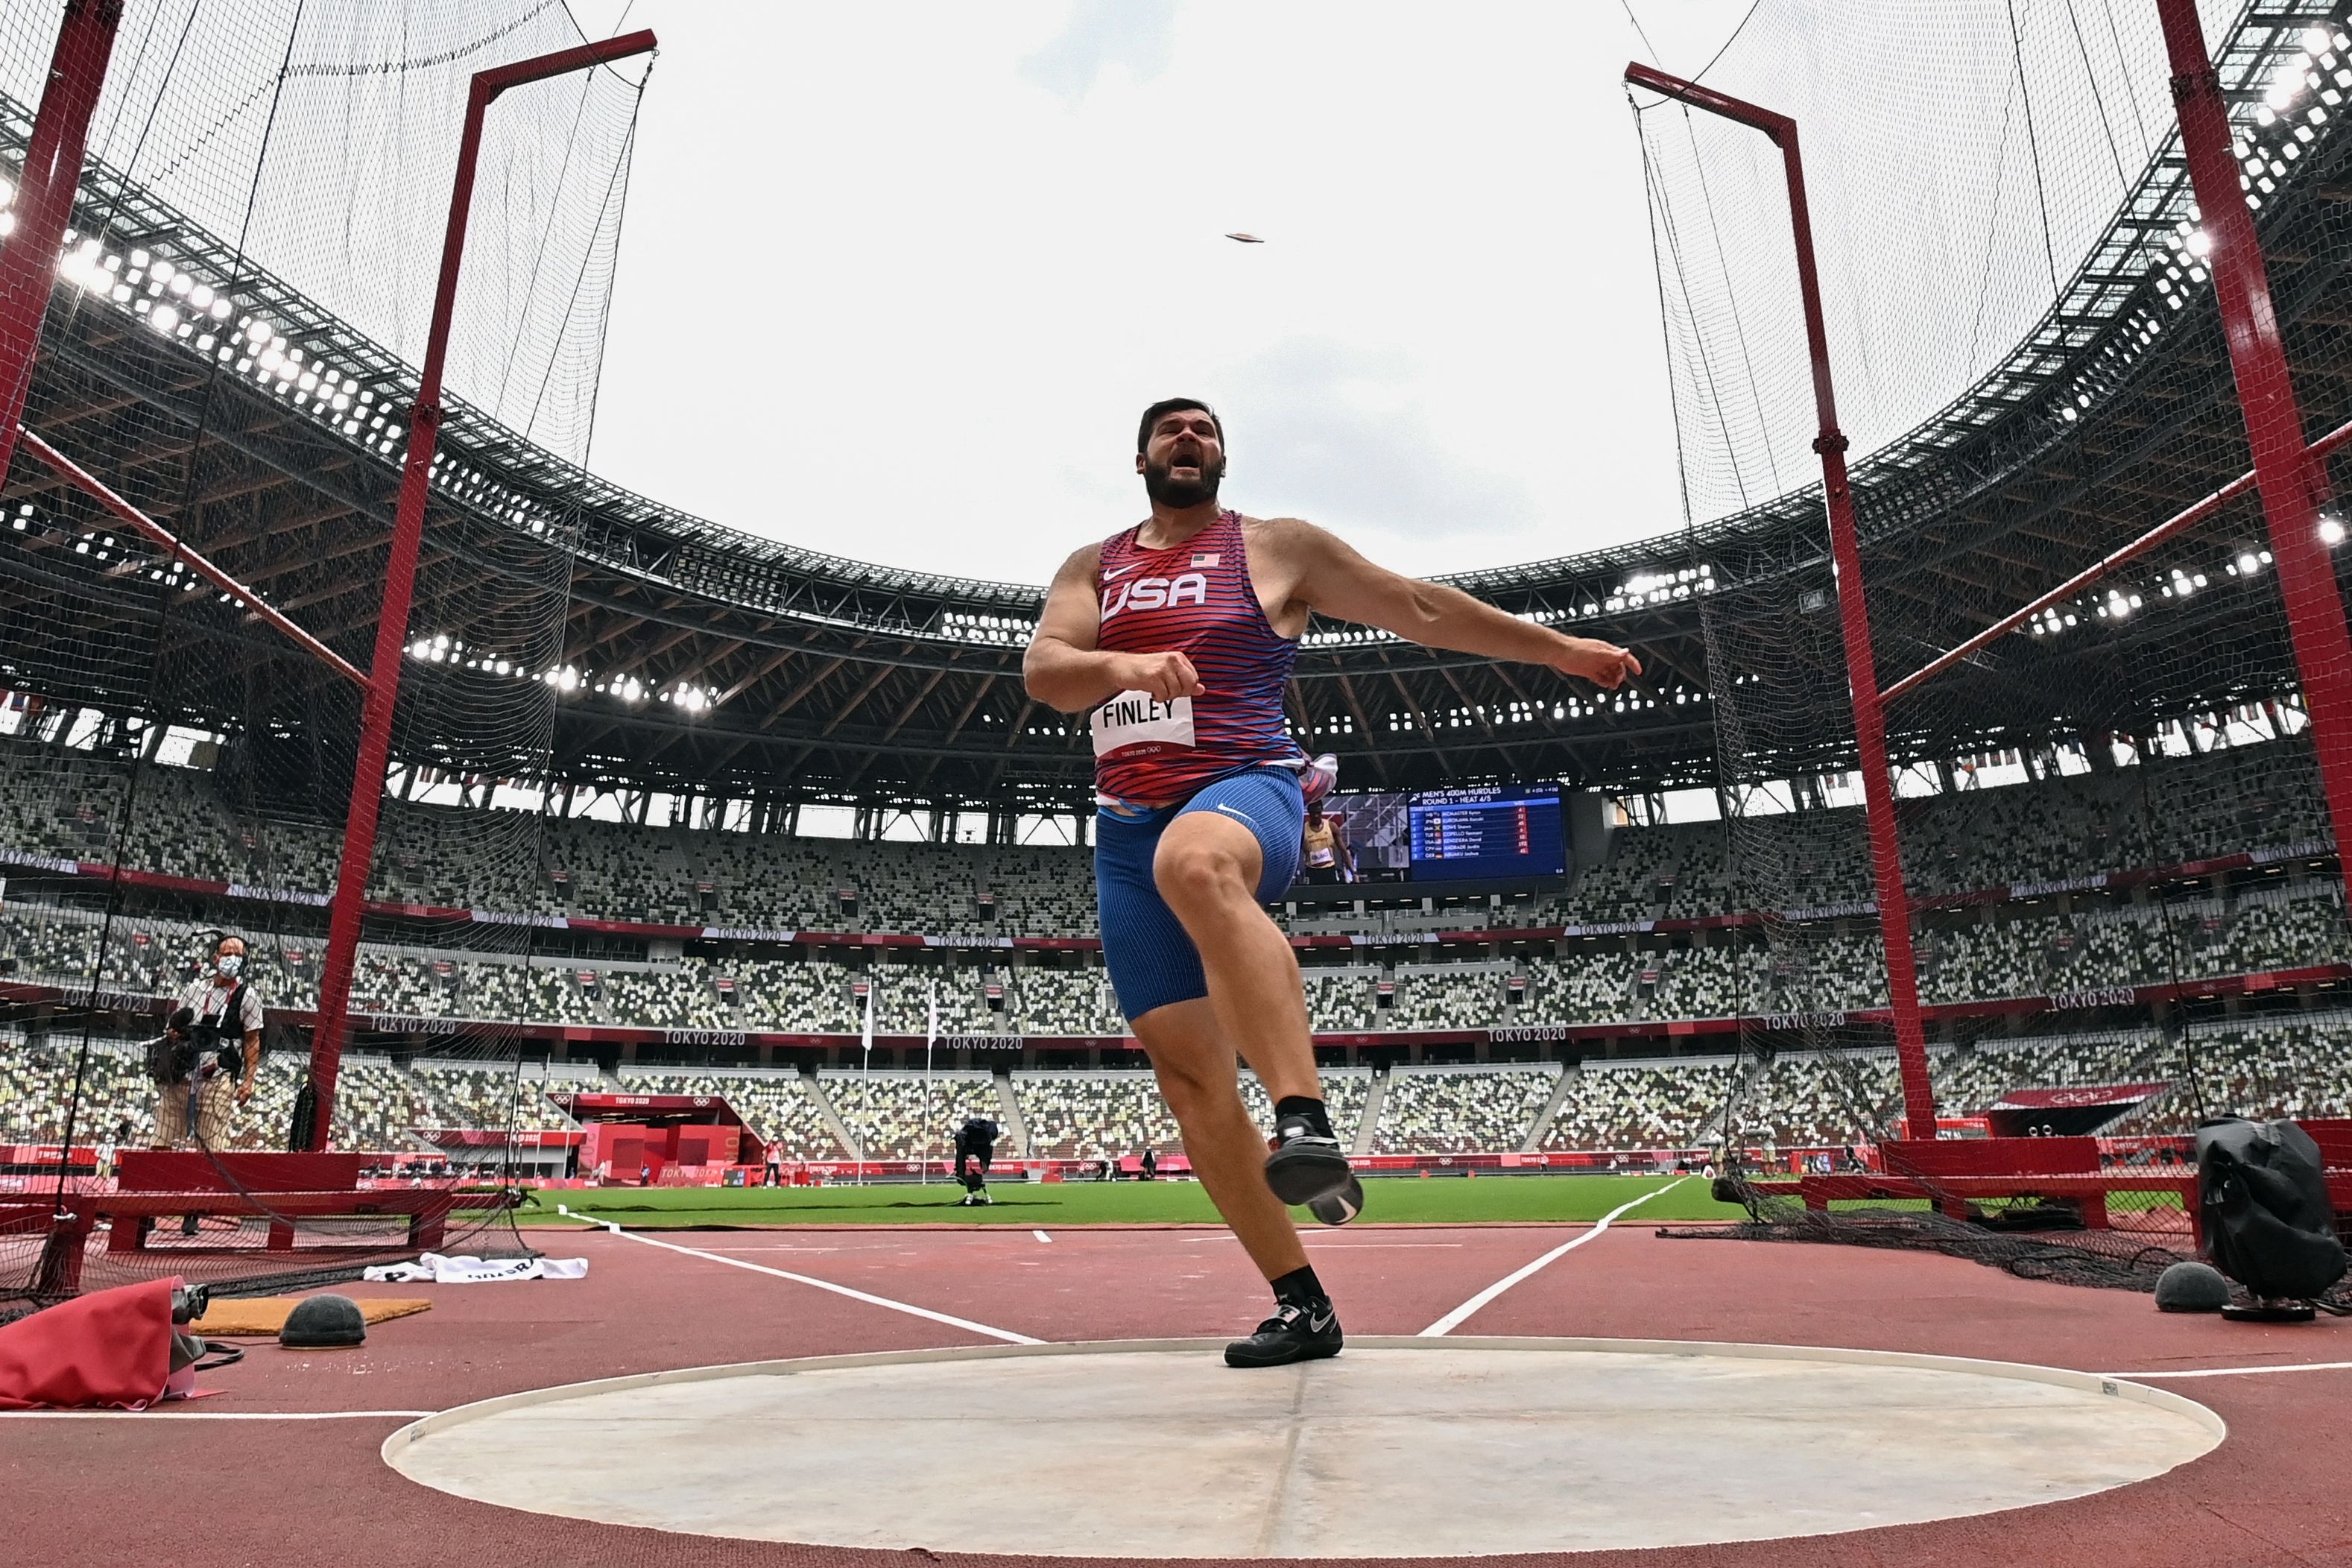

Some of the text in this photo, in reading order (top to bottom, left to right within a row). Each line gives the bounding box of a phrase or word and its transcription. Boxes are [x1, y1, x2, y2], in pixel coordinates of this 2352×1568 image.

[1101, 573, 1207, 622] USA
[1102, 697, 1174, 728] FINLEY
[1422, 787, 1501, 799] MEN'S 400M HURDLES
[1459, 796, 1477, 804] HEAT
[718, 929, 781, 941] TOKYO 2020
[1578, 920, 1640, 937] TOKYO 2020
[938, 935, 999, 948] TOKYO 2020
[1365, 932, 1425, 945] TOKYO 2020
[2049, 990, 2097, 1010] TOKYO
[371, 1015, 455, 1034] TOKYO 2020
[664, 1031, 745, 1046] TOKYO 2020
[945, 1037, 1023, 1049] TOKYO 2020
[1488, 1028, 1566, 1043] TOKYO 2020
